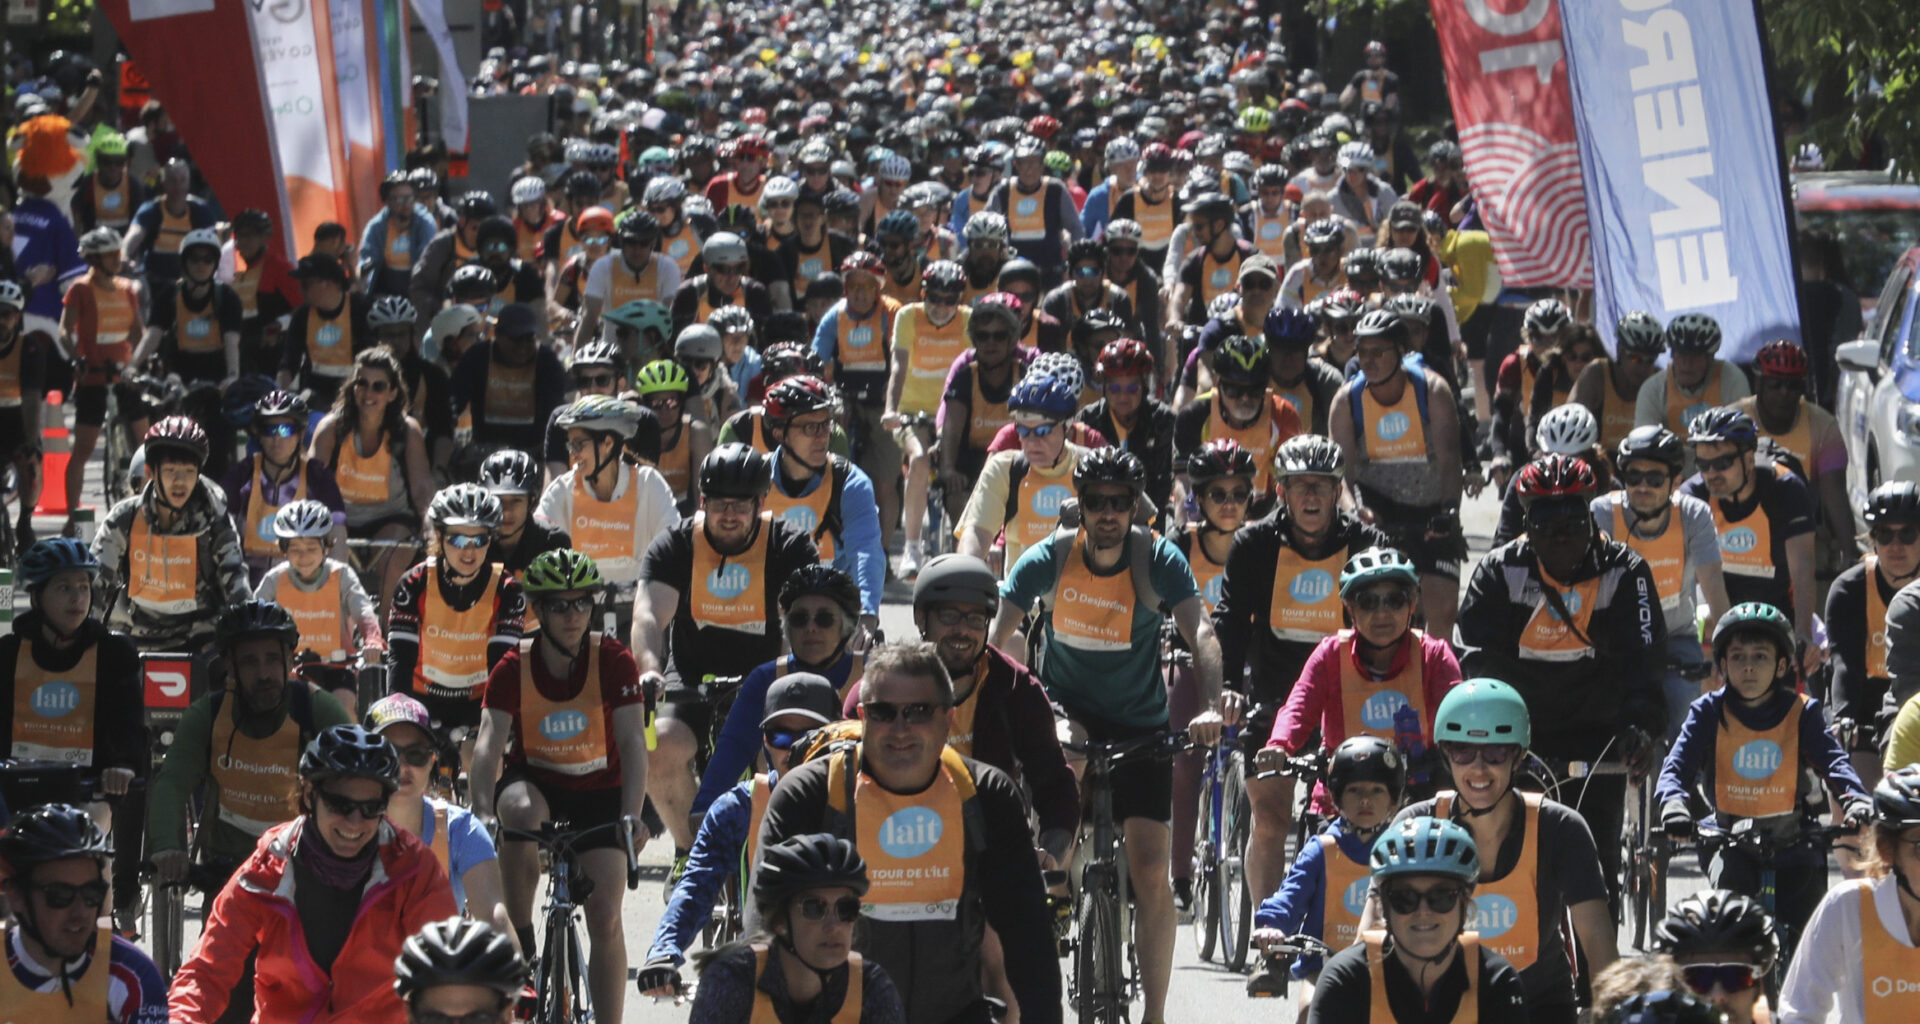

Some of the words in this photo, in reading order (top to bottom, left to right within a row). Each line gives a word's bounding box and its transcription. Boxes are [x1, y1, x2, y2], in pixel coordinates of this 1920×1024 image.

[1380, 416, 1408, 434] lait
[589, 518, 630, 532] Desjardins
[712, 567, 747, 589] lait
[1295, 571, 1331, 598] lait
[702, 603, 721, 612] TOUR
[723, 604, 735, 612] DE
[1079, 592, 1128, 614] Desjardins
[1281, 607, 1302, 617] TOUR
[1303, 608, 1316, 617] DE
[1063, 617, 1086, 631] TOUR
[441, 629, 487, 642] Desjardins
[36, 684, 78, 711] lait
[544, 711, 586, 734] lait
[1738, 740, 1779, 769] lait
[235, 760, 290, 776] Desjardins
[1727, 784, 1749, 795] TOUR
[1752, 786, 1764, 795] DE
[886, 812, 940, 845] lait
[872, 868, 905, 880] TOUR
[908, 867, 921, 878] DE
[925, 866, 950, 878] L'ÎLE
[1475, 903, 1514, 929] ait
[1501, 945, 1525, 955] L'ÎLE
